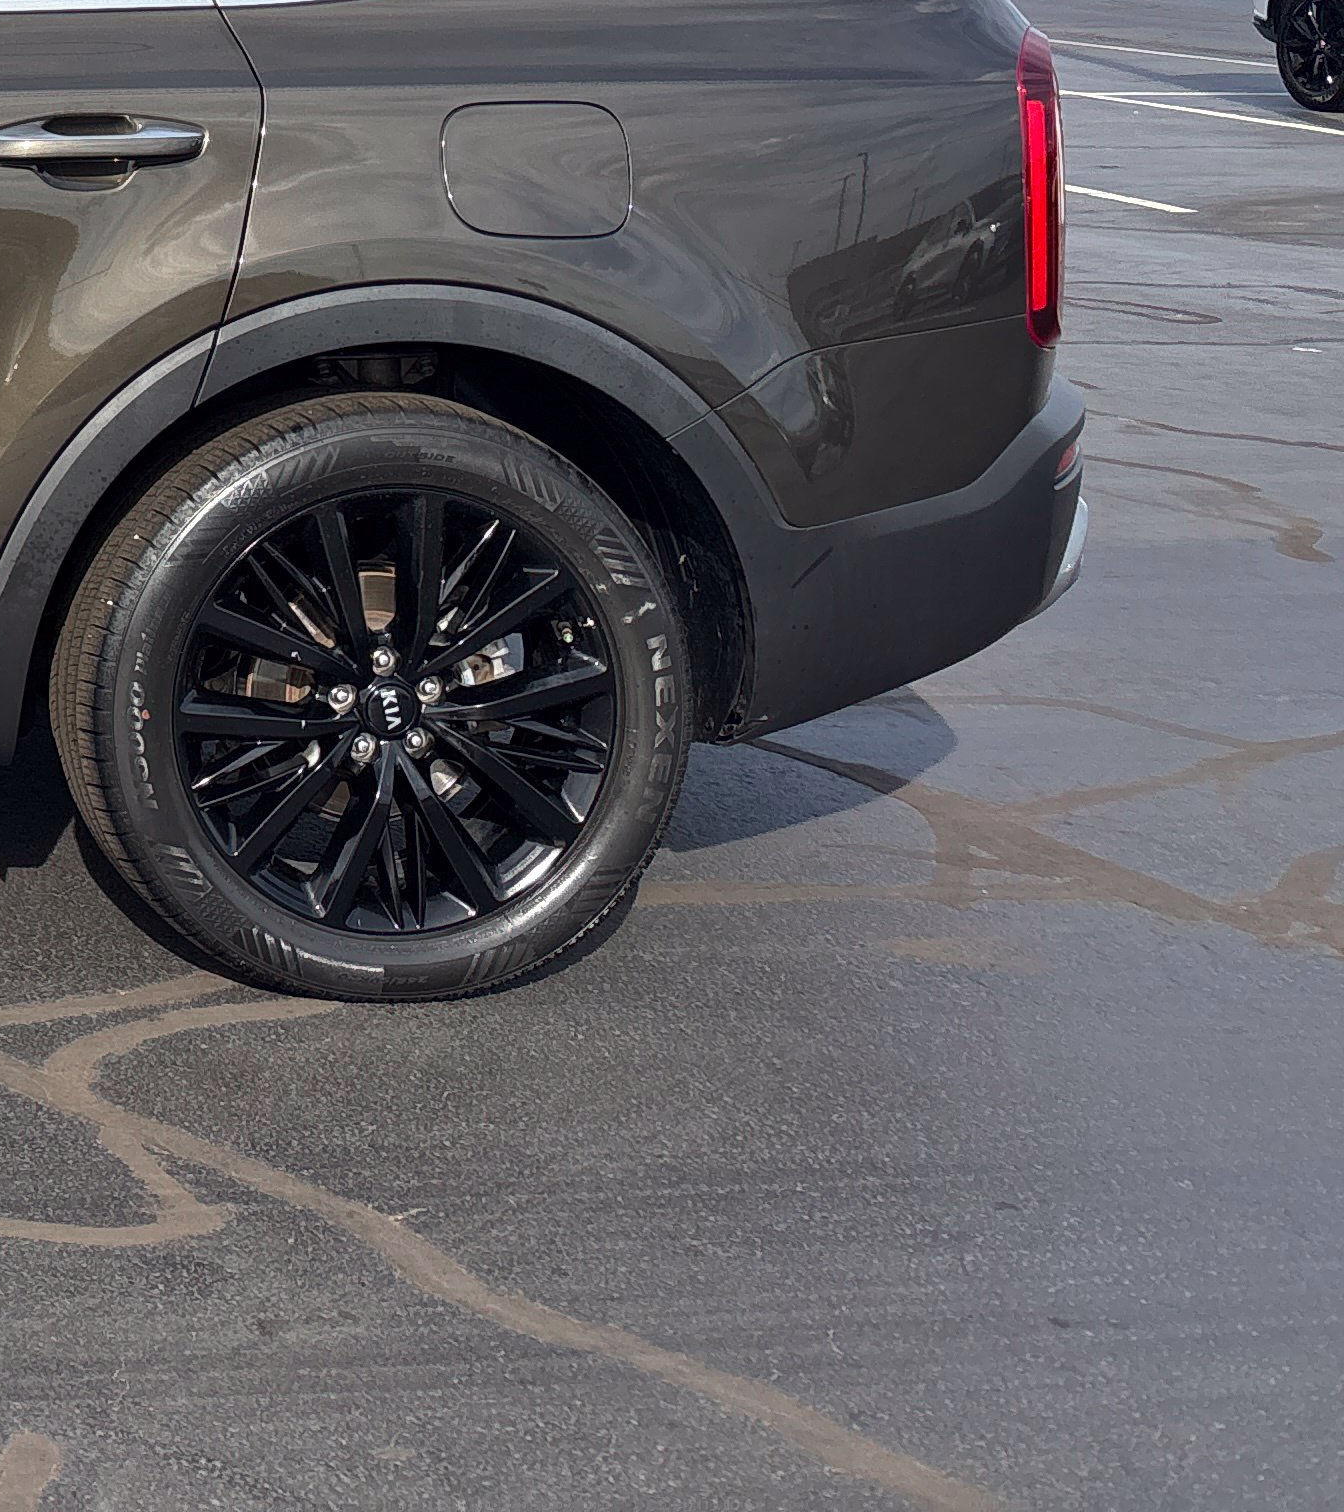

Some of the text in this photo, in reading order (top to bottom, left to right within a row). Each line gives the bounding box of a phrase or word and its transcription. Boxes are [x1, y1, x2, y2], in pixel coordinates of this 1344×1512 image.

[126, 681, 160, 810] N5000
[380, 689, 402, 731] KIA
[634, 634, 679, 825] NEXEN
